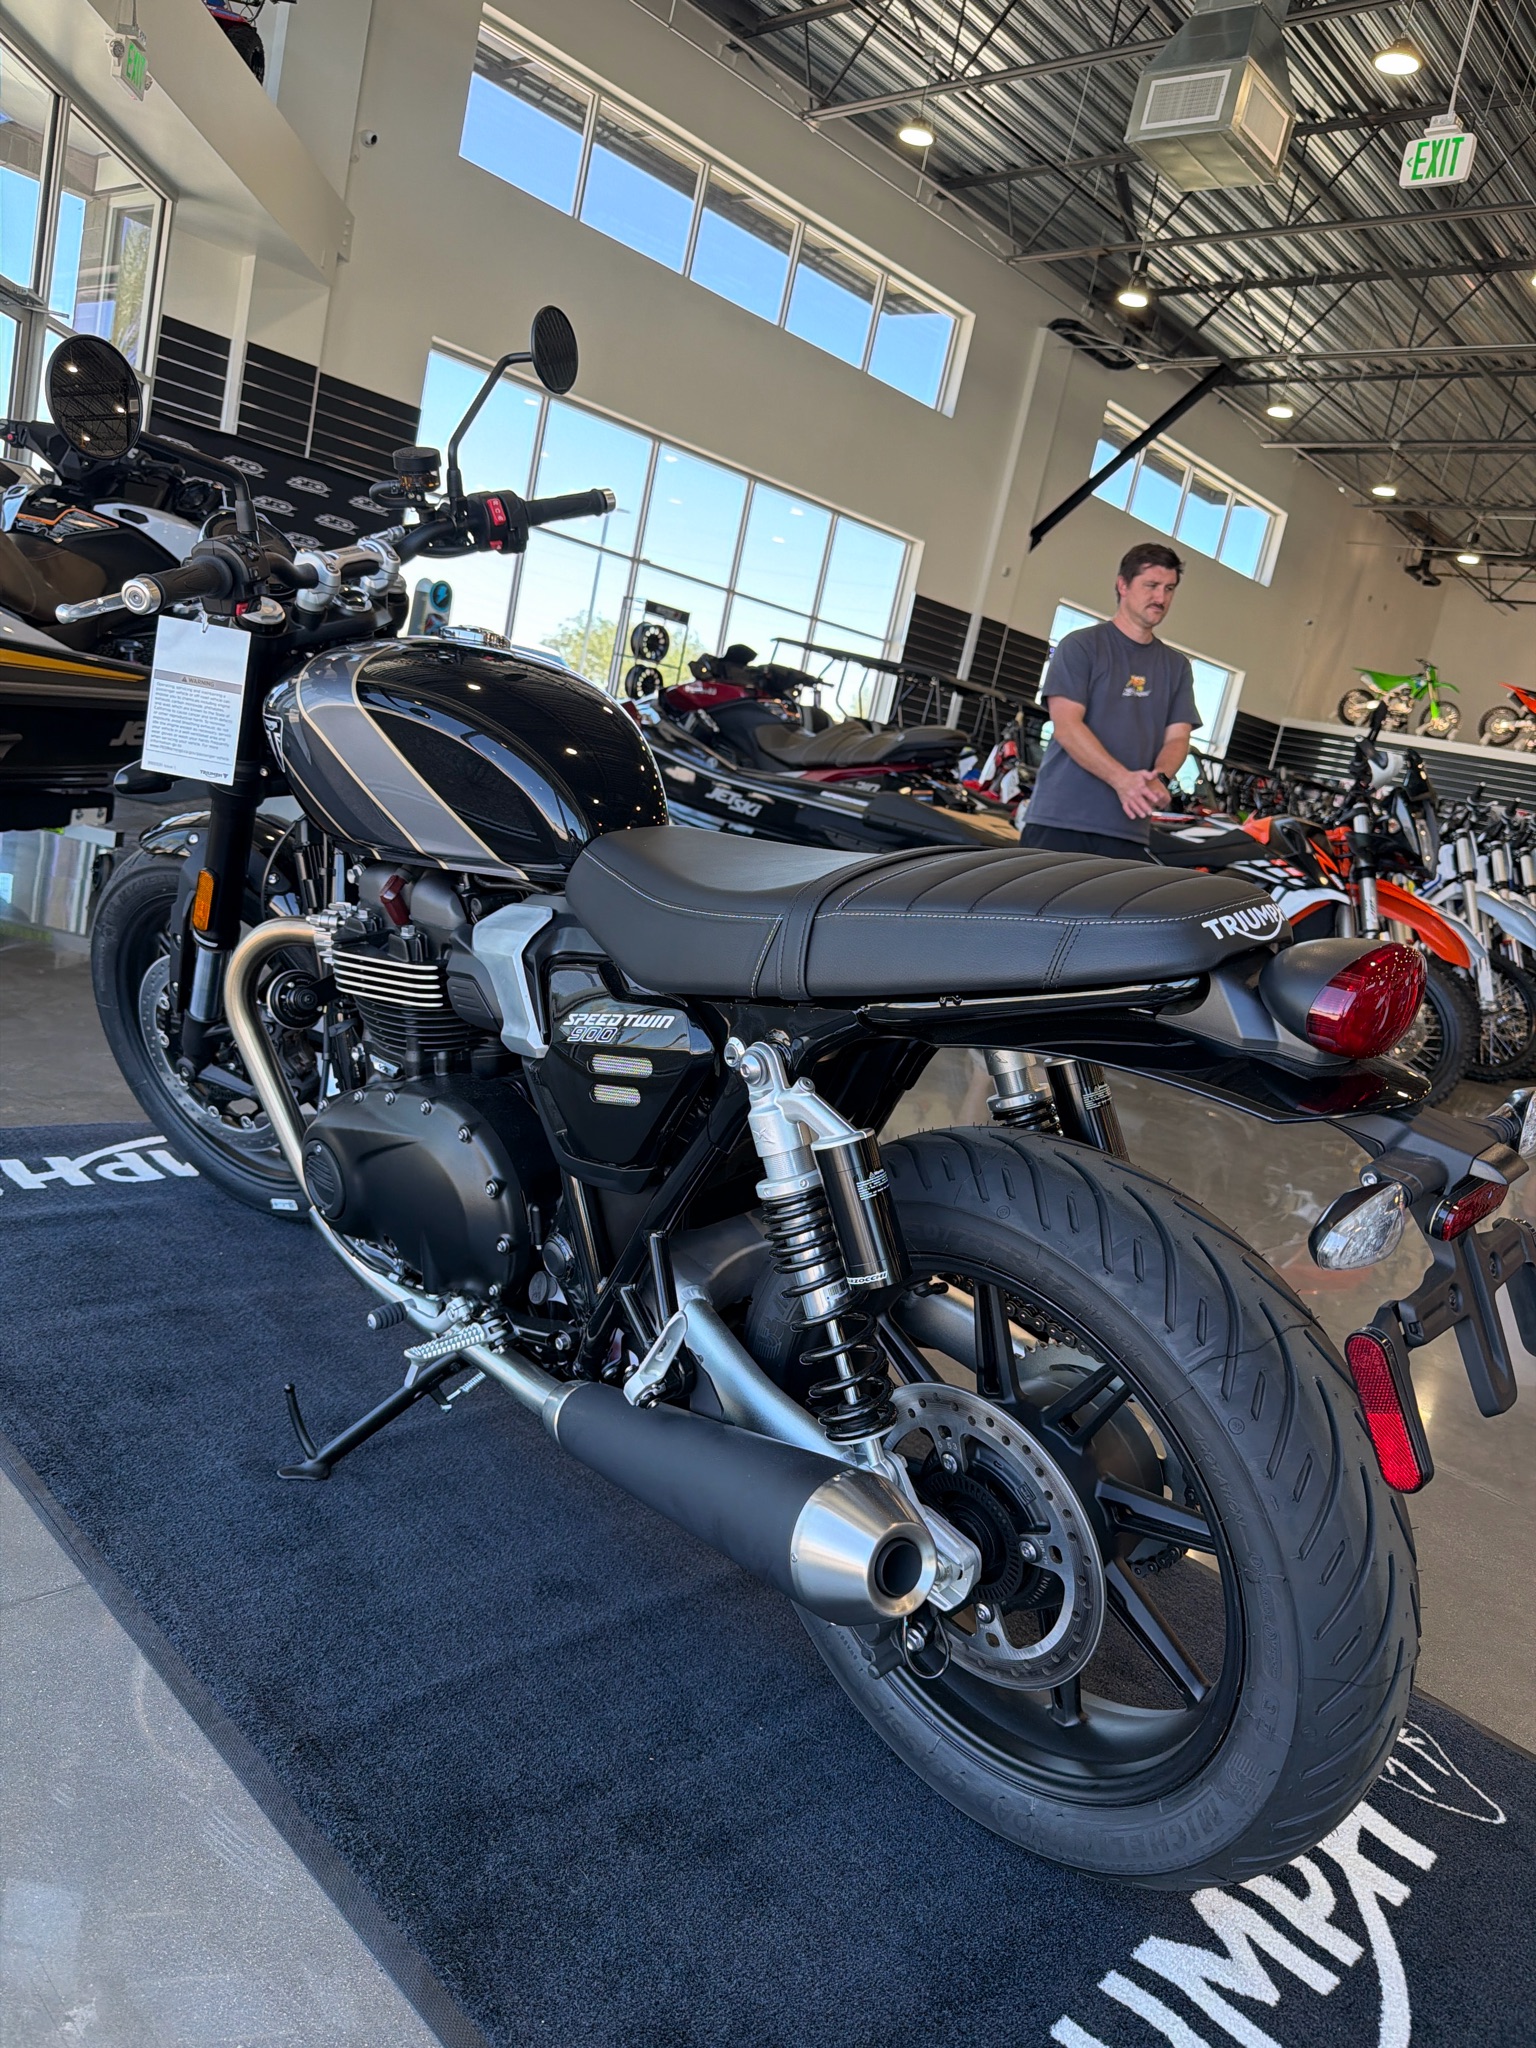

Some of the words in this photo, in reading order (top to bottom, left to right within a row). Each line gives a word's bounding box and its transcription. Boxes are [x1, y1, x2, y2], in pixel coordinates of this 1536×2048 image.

[1411, 137, 1465, 180] EXIT
[188, 677, 214, 687] WARNING
[1201, 903, 1289, 941] TRIUMPH
[623, 1014, 675, 1028] TWIN
[567, 1026, 618, 1042] 900
